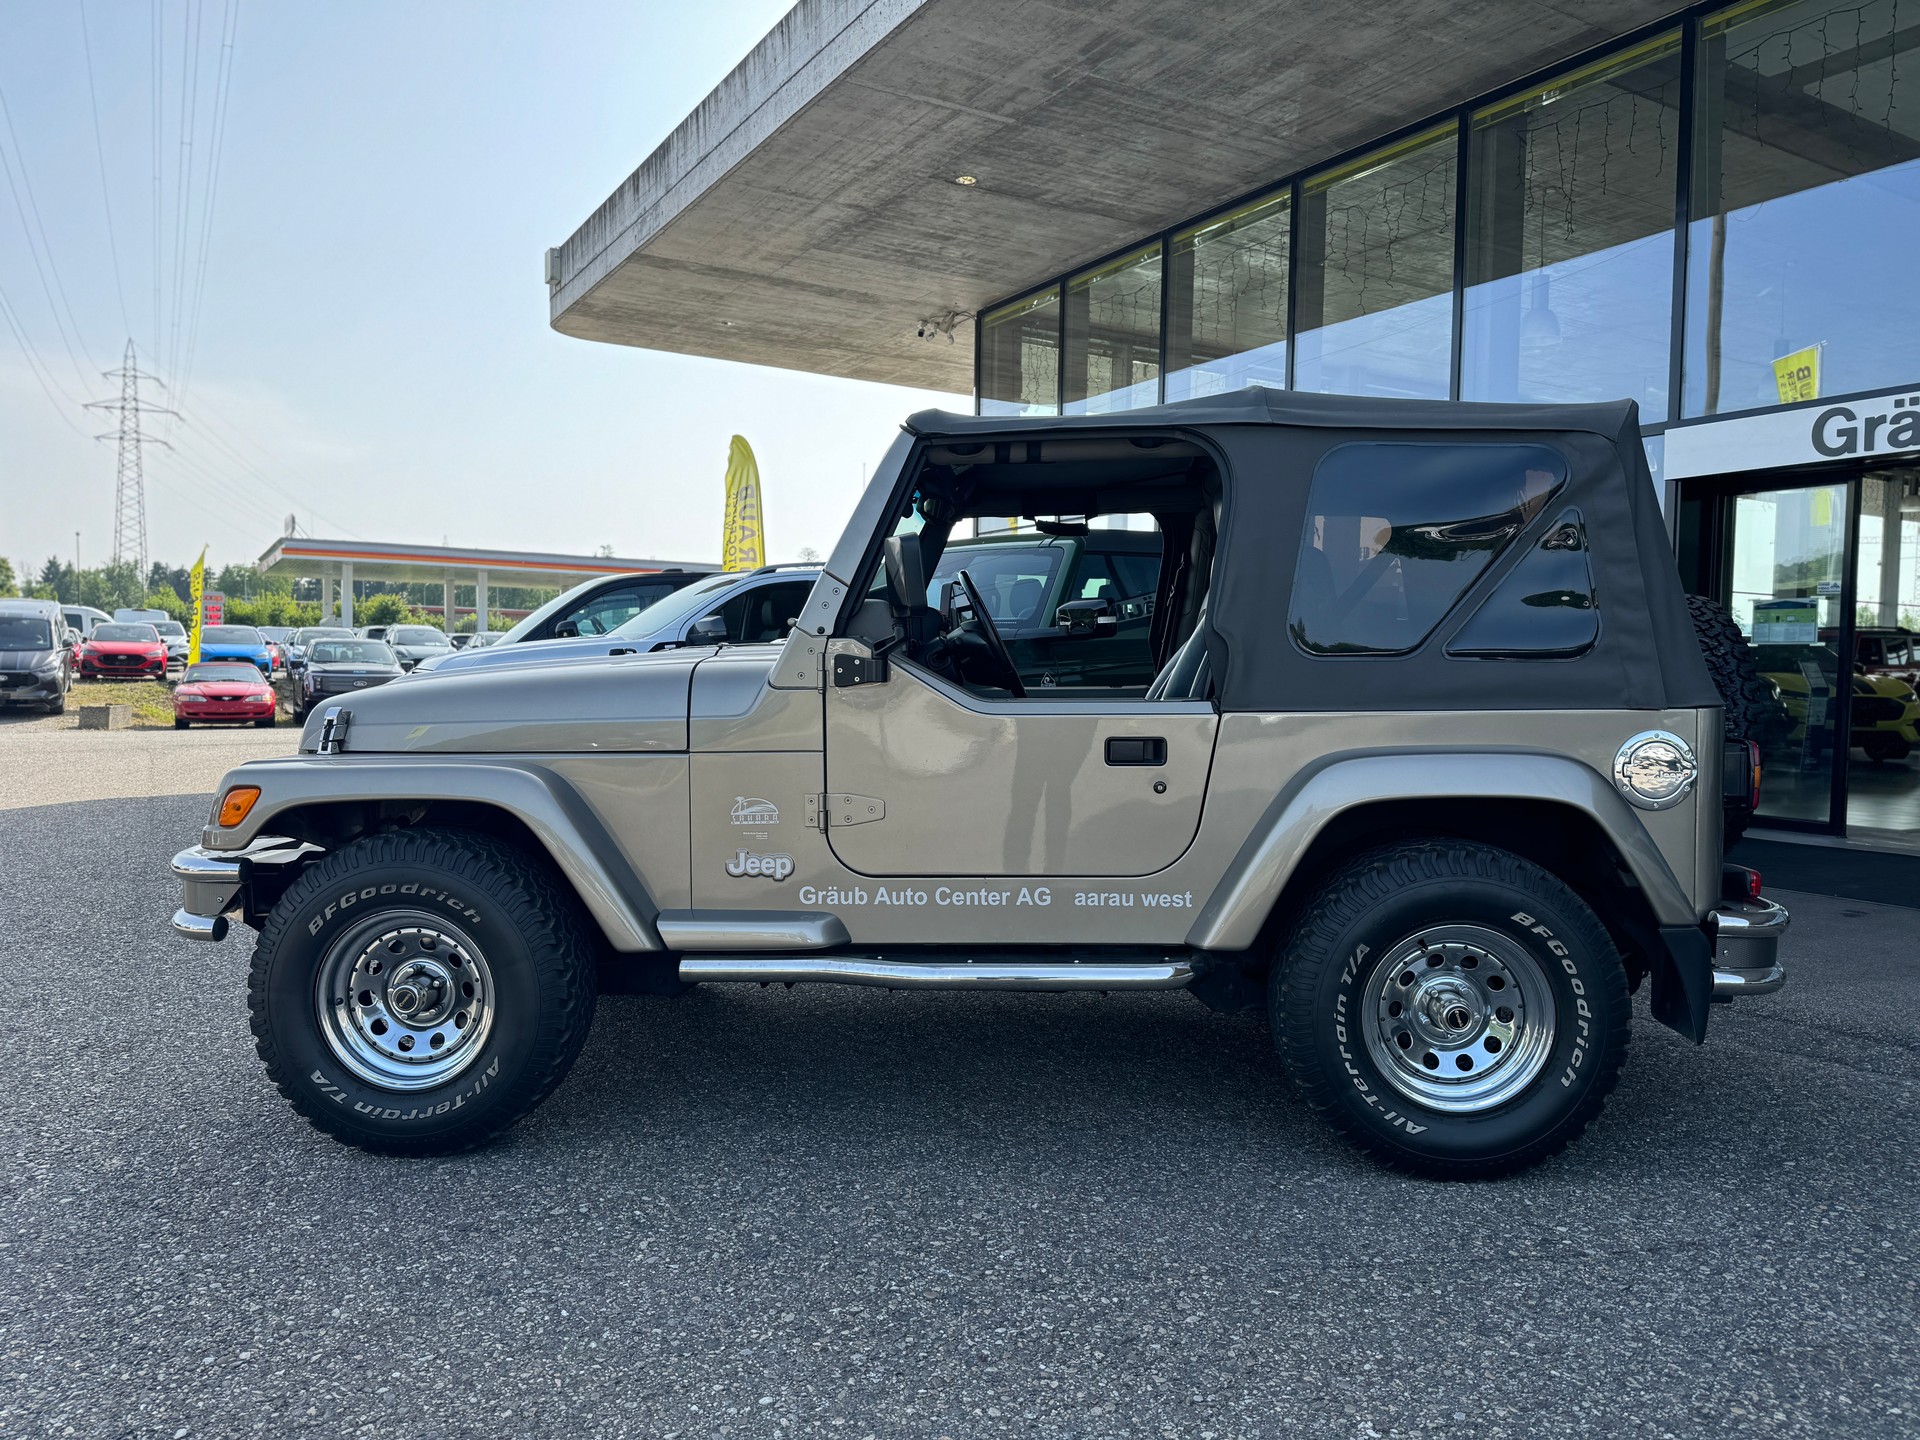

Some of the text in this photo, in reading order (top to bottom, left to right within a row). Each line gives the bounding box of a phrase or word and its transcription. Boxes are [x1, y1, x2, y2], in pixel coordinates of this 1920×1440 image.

[1811, 396, 1920, 457] Grä
[732, 814, 778, 822] SAHARA
[728, 852, 792, 878] Jeep
[308, 882, 483, 936] BFGoodrich
[799, 886, 1193, 908] Gräub Auto Center AG aarau west
[1510, 911, 1593, 1089] BFGoodrich
[1334, 943, 1429, 1136] All-Terrain T/A
[308, 1056, 502, 1121] All-Terrain T/A
